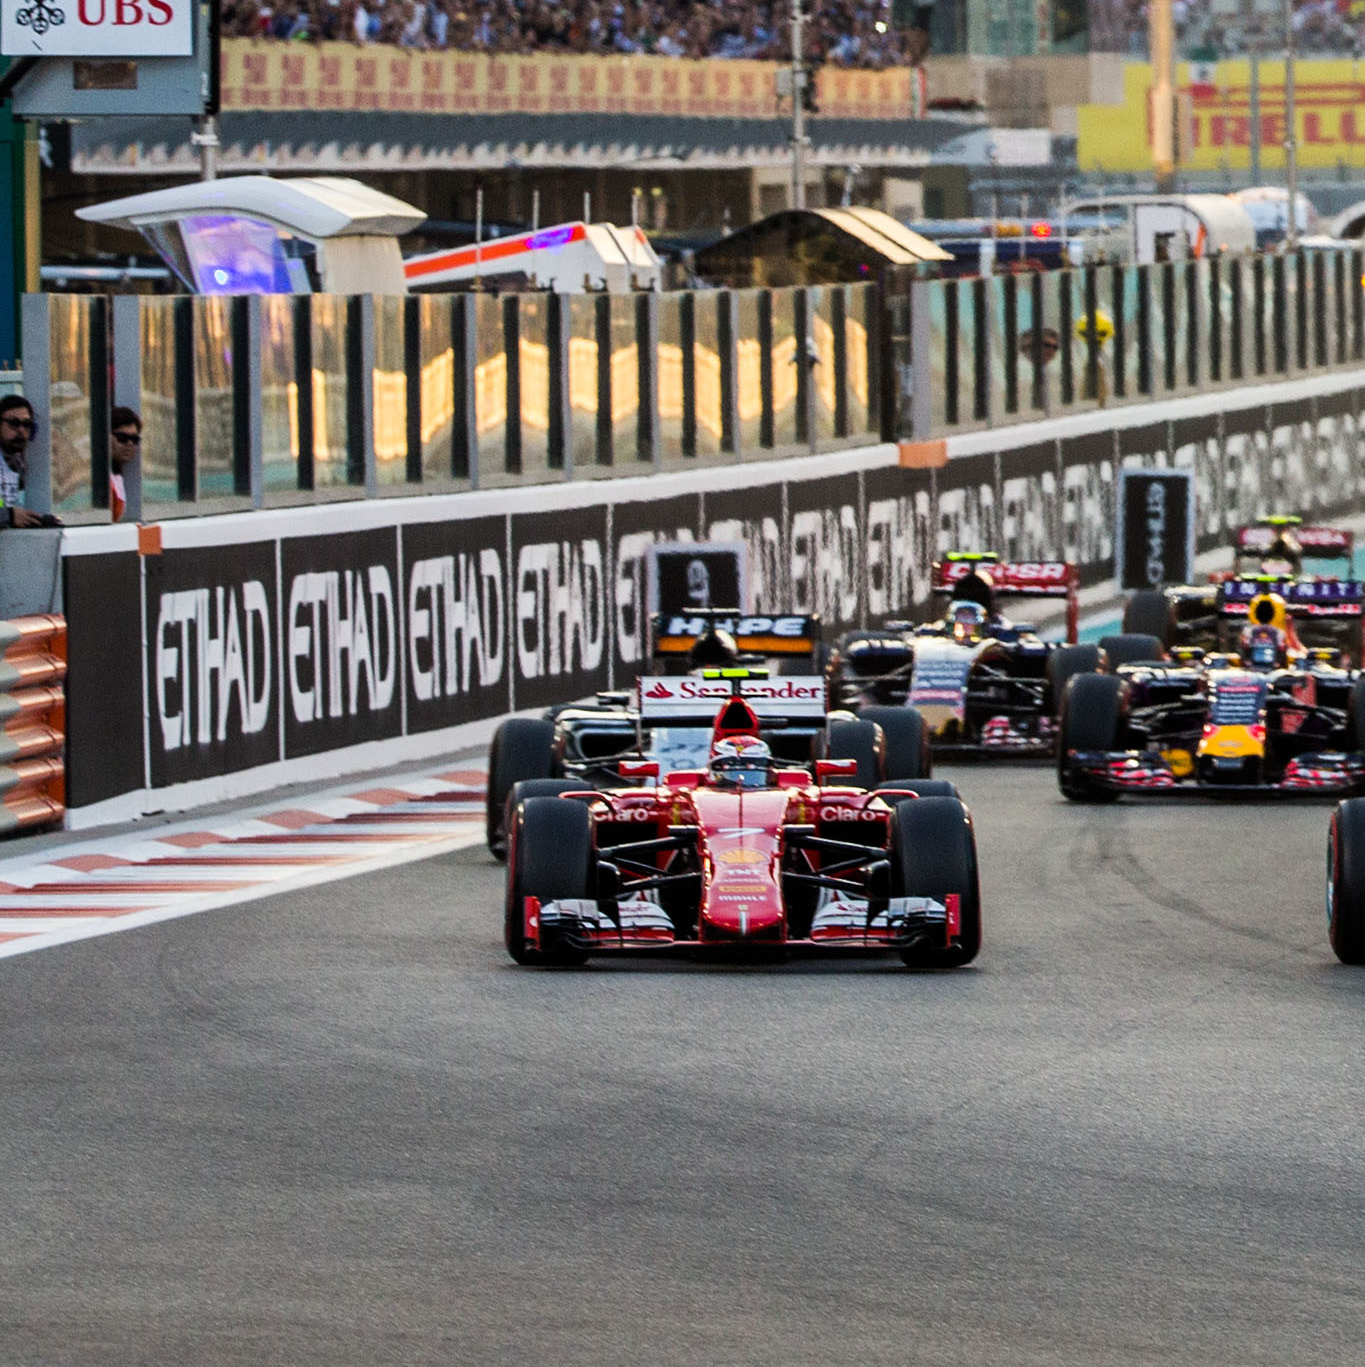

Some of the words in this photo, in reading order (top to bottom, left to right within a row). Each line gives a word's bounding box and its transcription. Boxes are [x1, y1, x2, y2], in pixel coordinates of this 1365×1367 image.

[156, 580, 271, 752] ETIHAD
[289, 564, 396, 723] ETIHAD
[409, 548, 504, 701] ETIHAD
[516, 538, 604, 679] ETIHAD
[679, 681, 822, 701] Sanander
[820, 805, 877, 822] Claro
